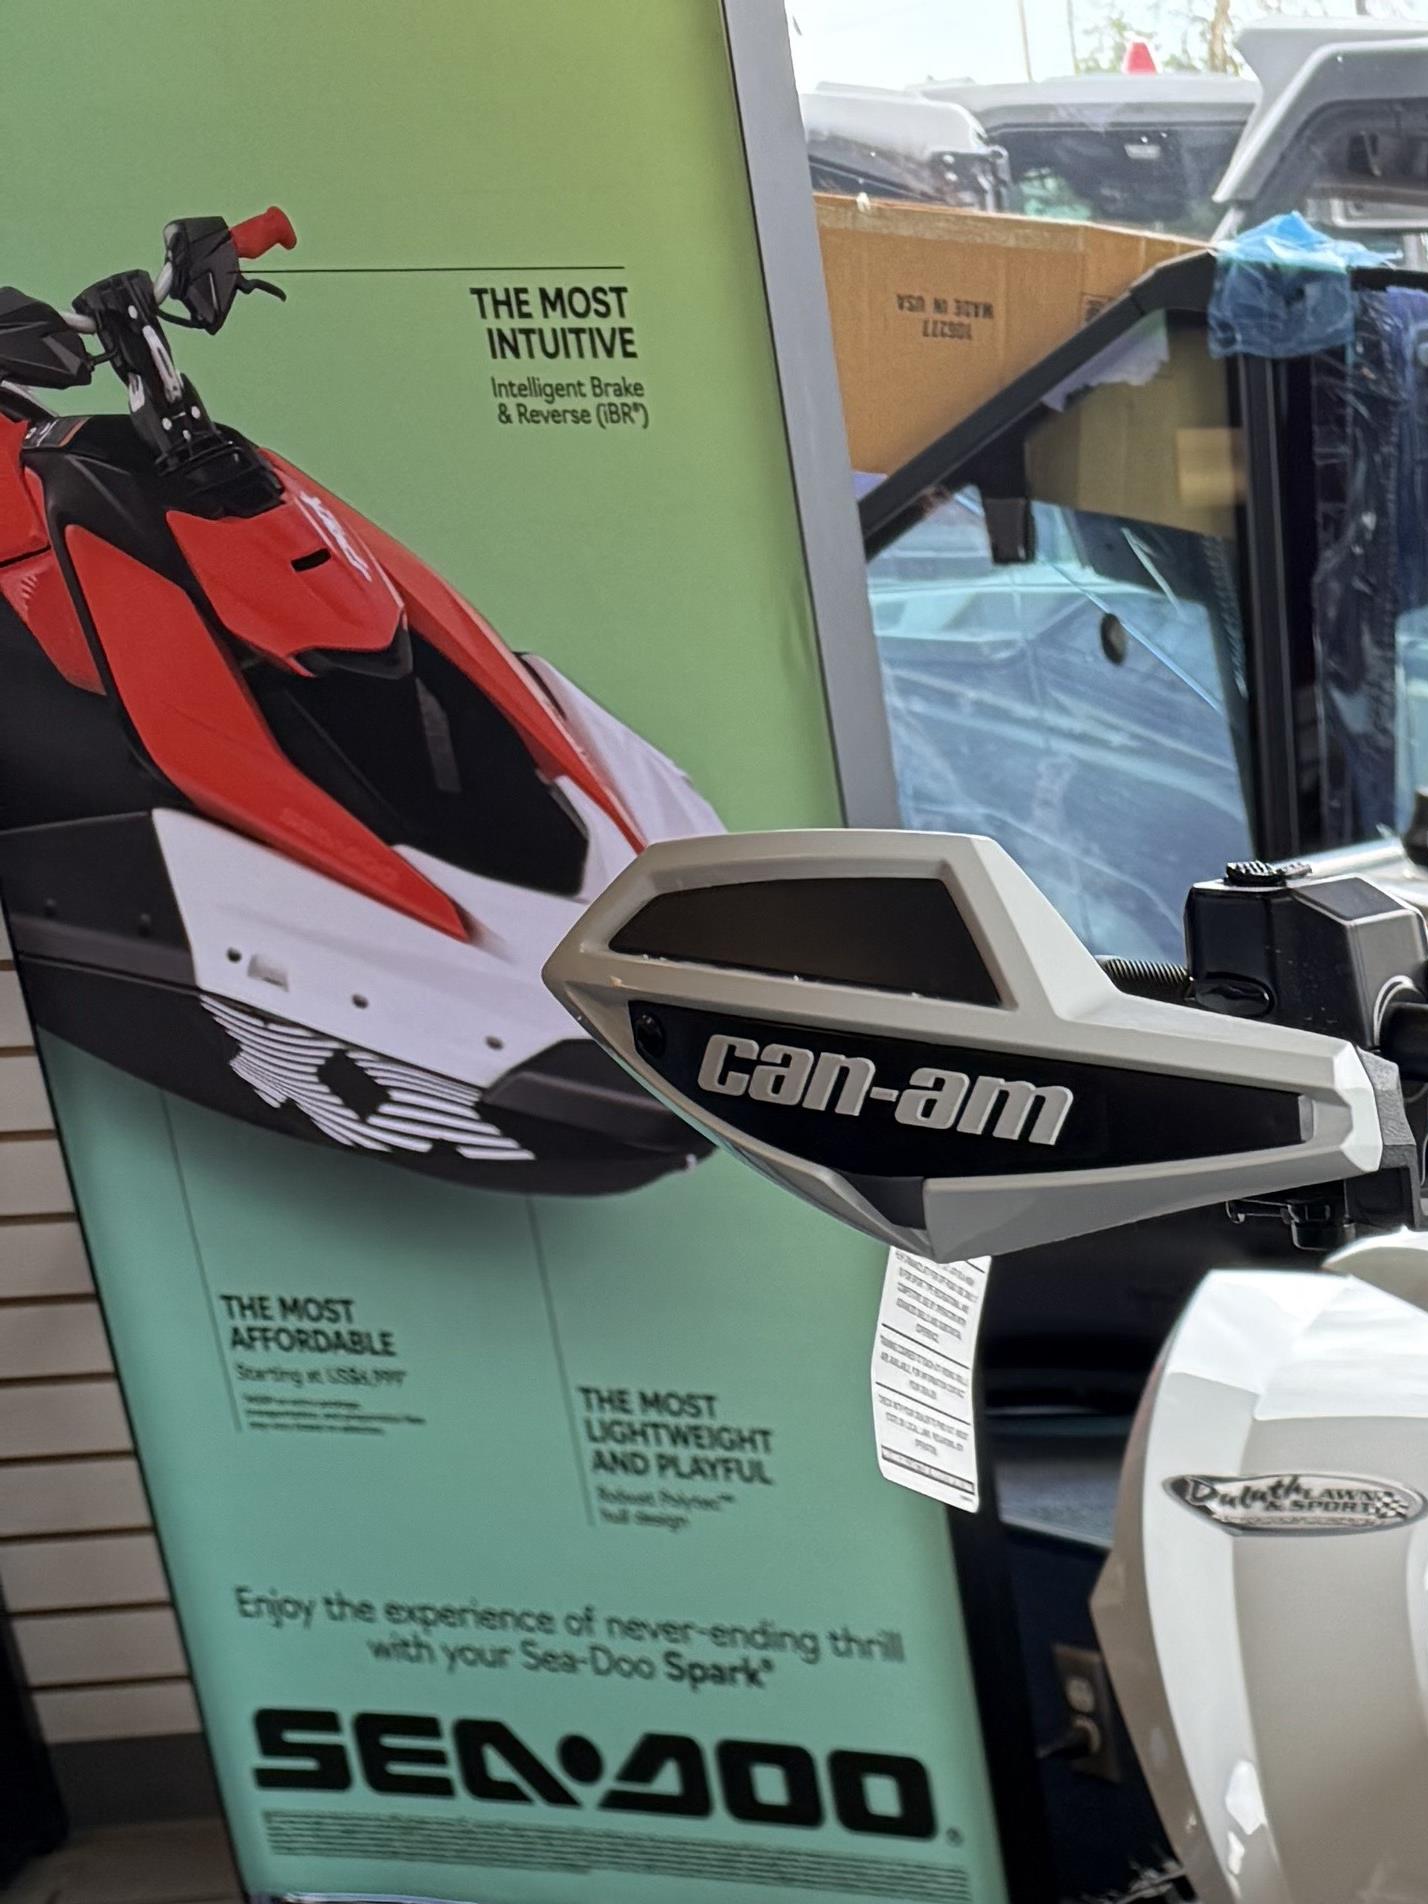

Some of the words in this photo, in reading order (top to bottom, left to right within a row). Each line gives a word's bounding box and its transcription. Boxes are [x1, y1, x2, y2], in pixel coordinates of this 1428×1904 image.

[469, 287, 533, 319] THE
[538, 286, 628, 319] MOST
[486, 327, 638, 359] INTUITIVE
[491, 376, 587, 404] Intelligent
[590, 376, 644, 397] Brake
[498, 403, 513, 424] &
[516, 403, 592, 424] Reverse
[697, 1034, 1073, 1146] can-am
[219, 1294, 272, 1320] THE
[279, 1297, 354, 1324] MOST
[231, 1327, 397, 1357] AFFORDABLE
[578, 1386, 632, 1414] THE
[638, 1391, 717, 1418] MOST
[585, 1417, 772, 1453] LIGHTWEIGHT
[592, 1449, 649, 1476] AND
[656, 1454, 773, 1485] PLAYFUL
[235, 1585, 313, 1629] Enjoy
[322, 1590, 376, 1623] the
[384, 1596, 555, 1635] experience
[564, 1605, 594, 1637] of
[606, 1614, 820, 1665] never-ending
[829, 1627, 905, 1663] thrill
[367, 1630, 437, 1664] with
[442, 1643, 512, 1674] your
[519, 1639, 655, 1679] Sea-Doo
